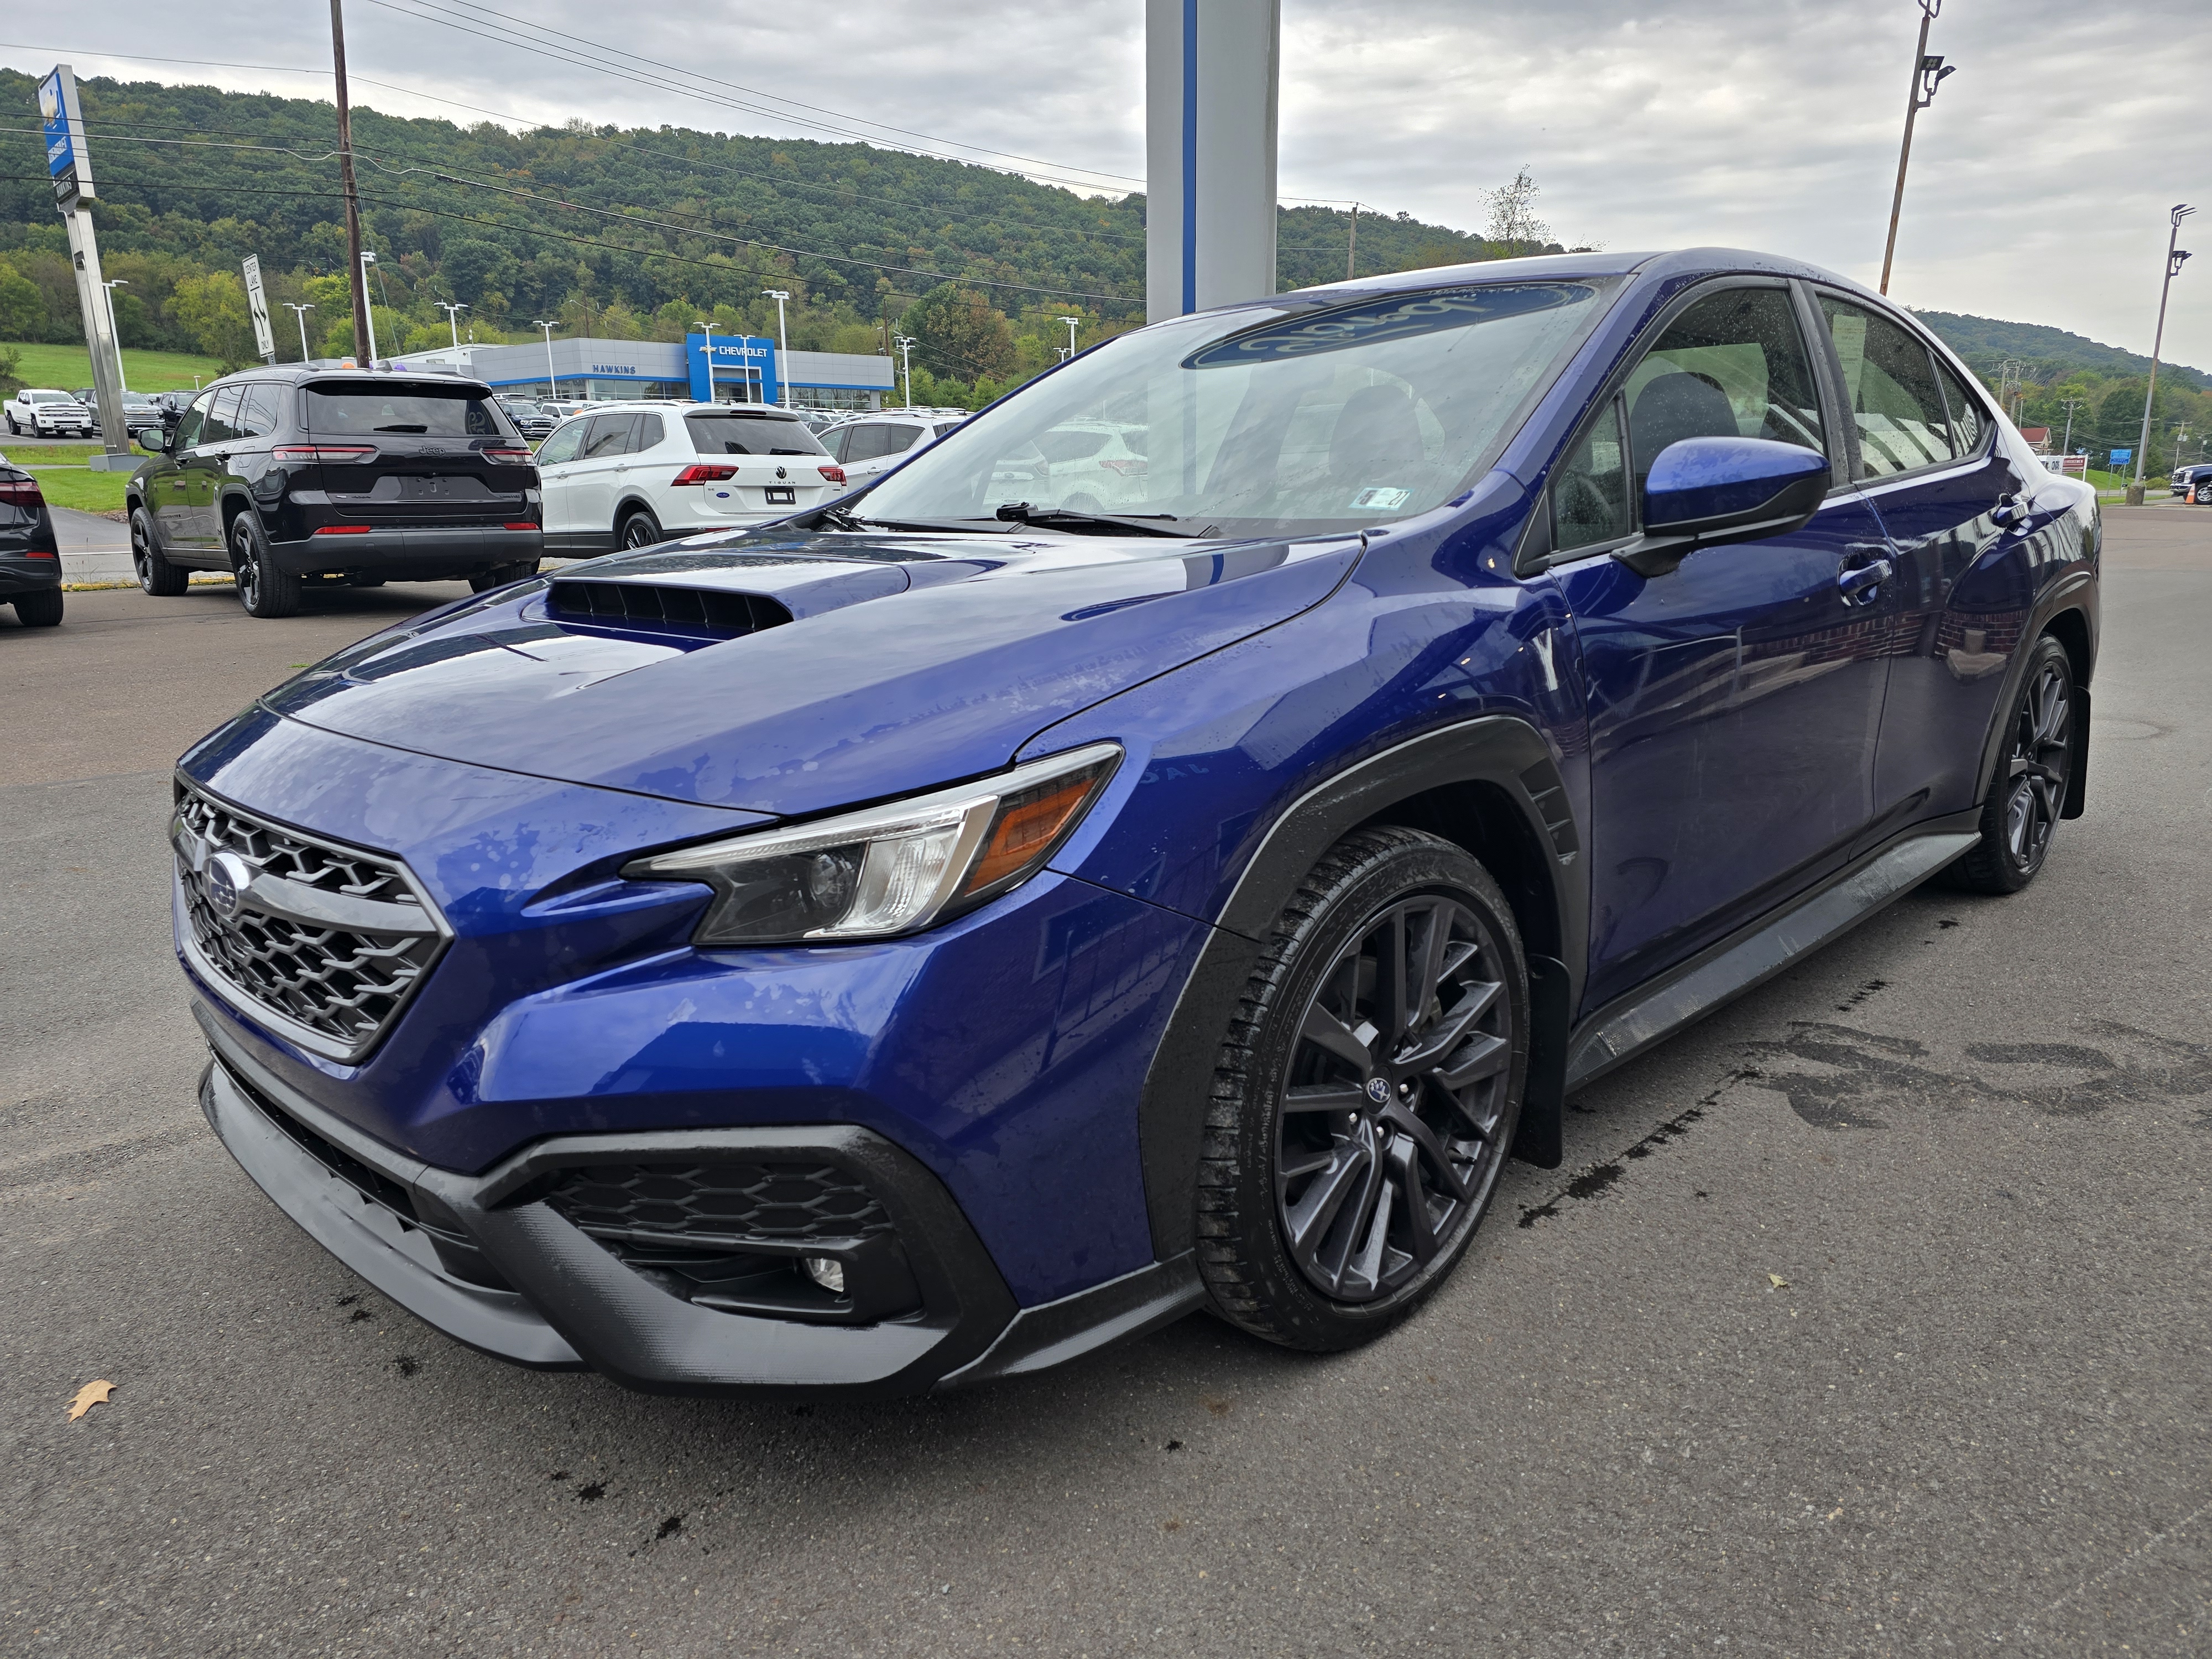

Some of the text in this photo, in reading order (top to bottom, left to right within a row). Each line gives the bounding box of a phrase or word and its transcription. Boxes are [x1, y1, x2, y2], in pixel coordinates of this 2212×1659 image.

[246, 262, 257, 274] CENTER
[249, 274, 258, 286] LANE
[261, 339, 269, 349] ONLY
[719, 346, 767, 357] CHEVROLET
[593, 364, 635, 374] HAWKINS
[418, 445, 446, 457] Jeep
[1388, 491, 1410, 506] 27
